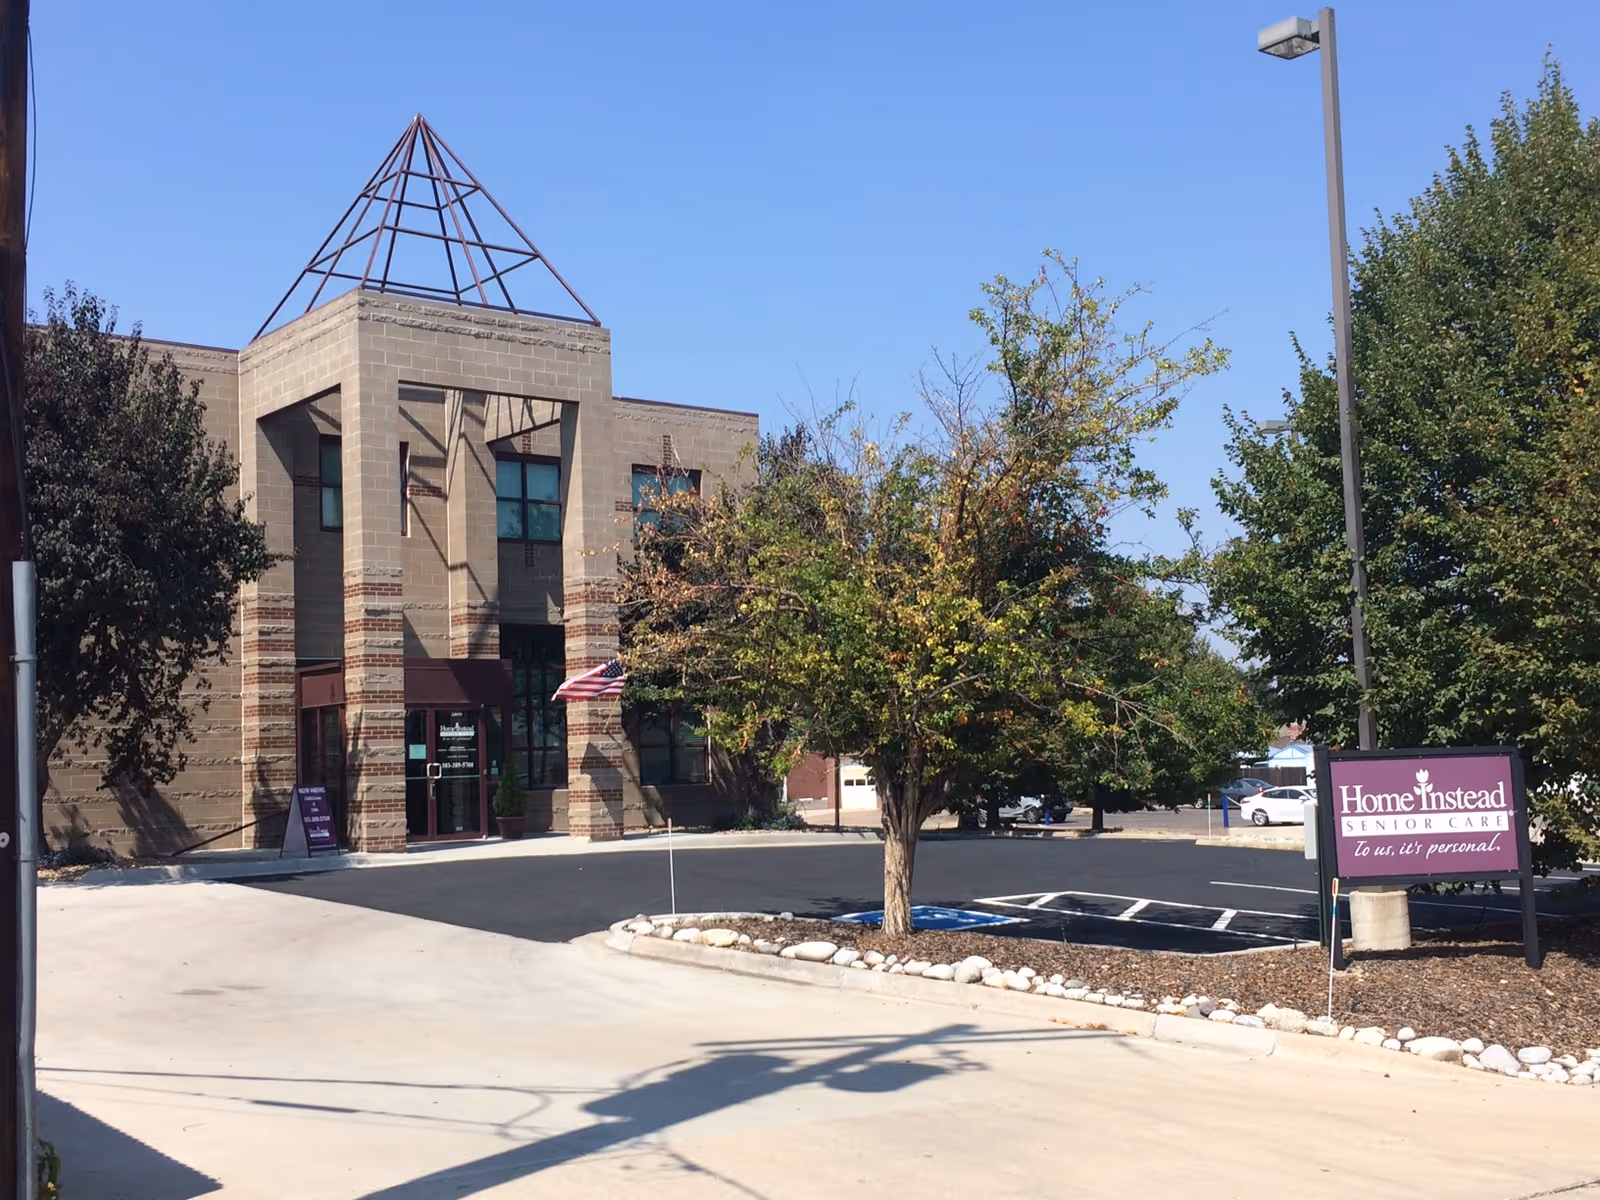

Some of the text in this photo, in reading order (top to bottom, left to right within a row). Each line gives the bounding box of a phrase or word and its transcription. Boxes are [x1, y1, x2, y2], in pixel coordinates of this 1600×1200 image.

[1338, 781, 1507, 814] Home Instead
[1346, 815, 1503, 832] SENIOR CARE
[1354, 840, 1371, 857] To
[1399, 840, 1423, 855] it's
[1425, 832, 1501, 860] personal.
